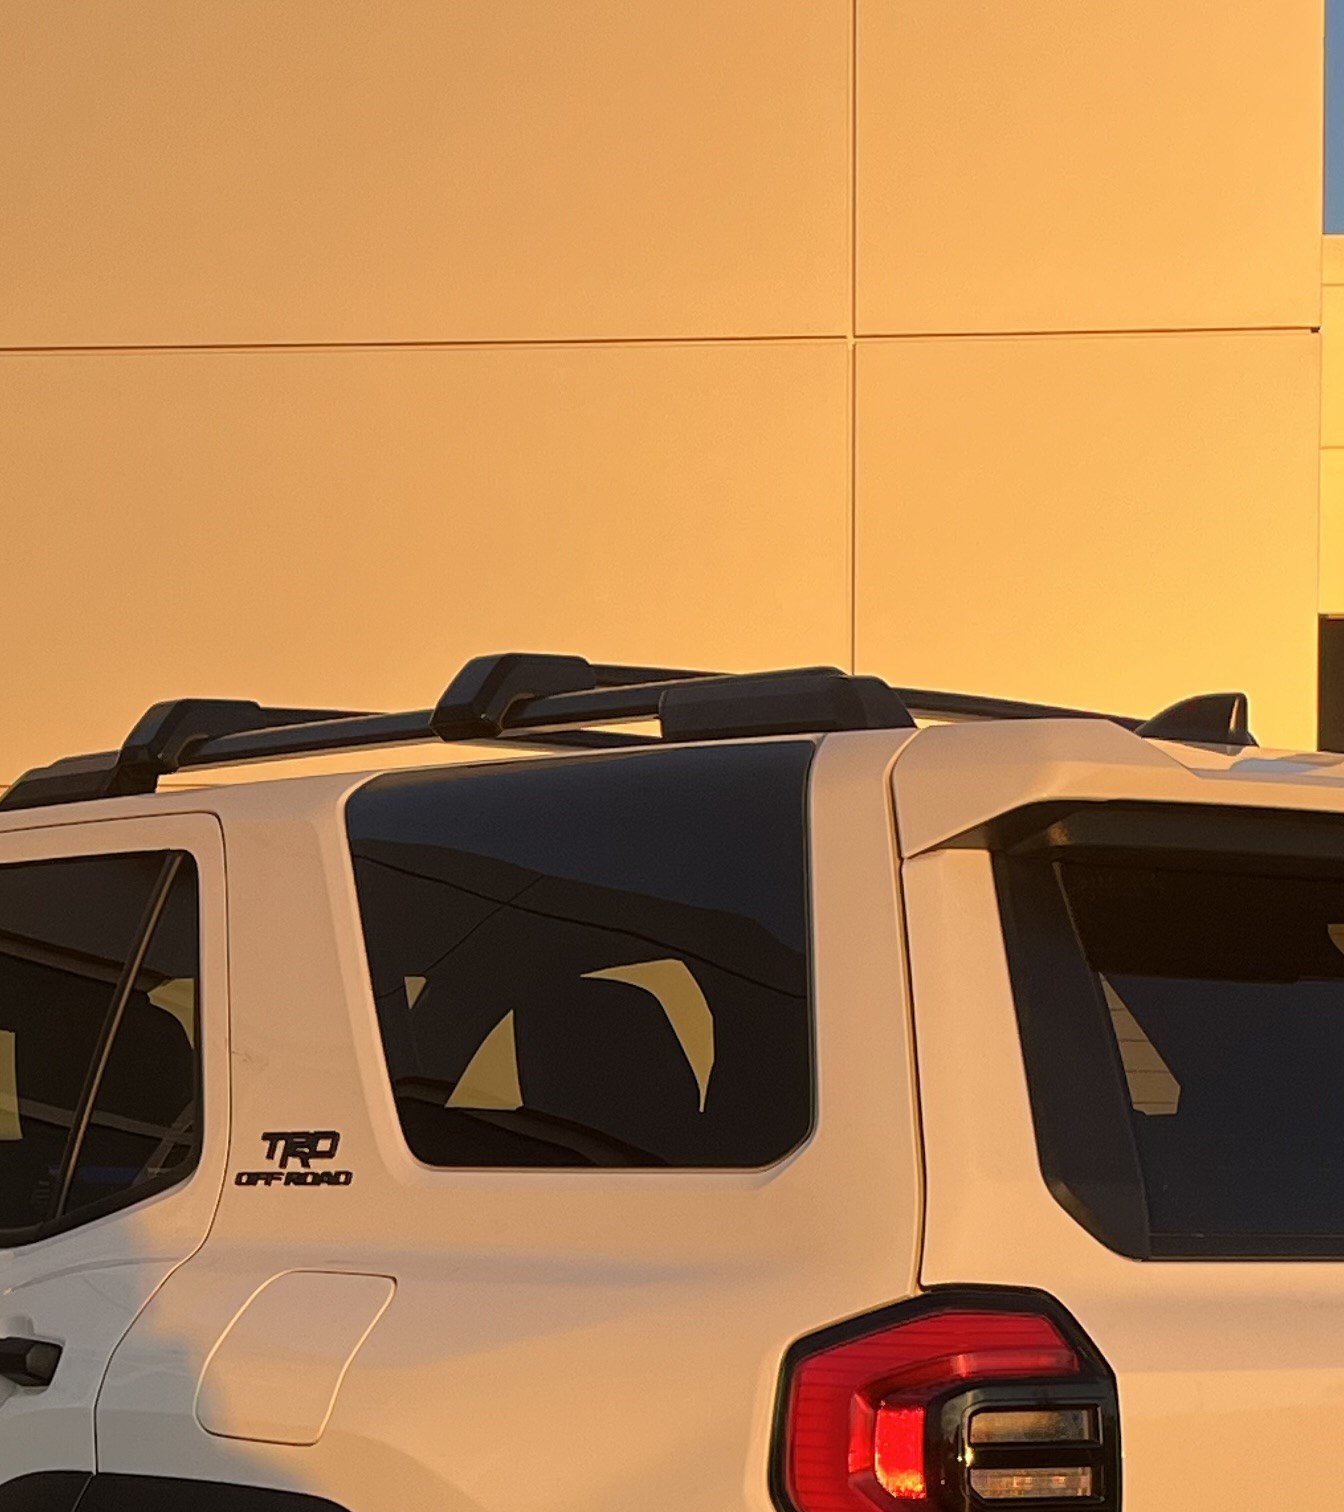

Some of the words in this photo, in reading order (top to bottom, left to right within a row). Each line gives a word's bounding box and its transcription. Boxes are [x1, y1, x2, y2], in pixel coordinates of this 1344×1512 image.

[261, 1131, 340, 1169] TRD
[235, 1172, 285, 1187] OFF
[284, 1171, 353, 1187] ROAD
